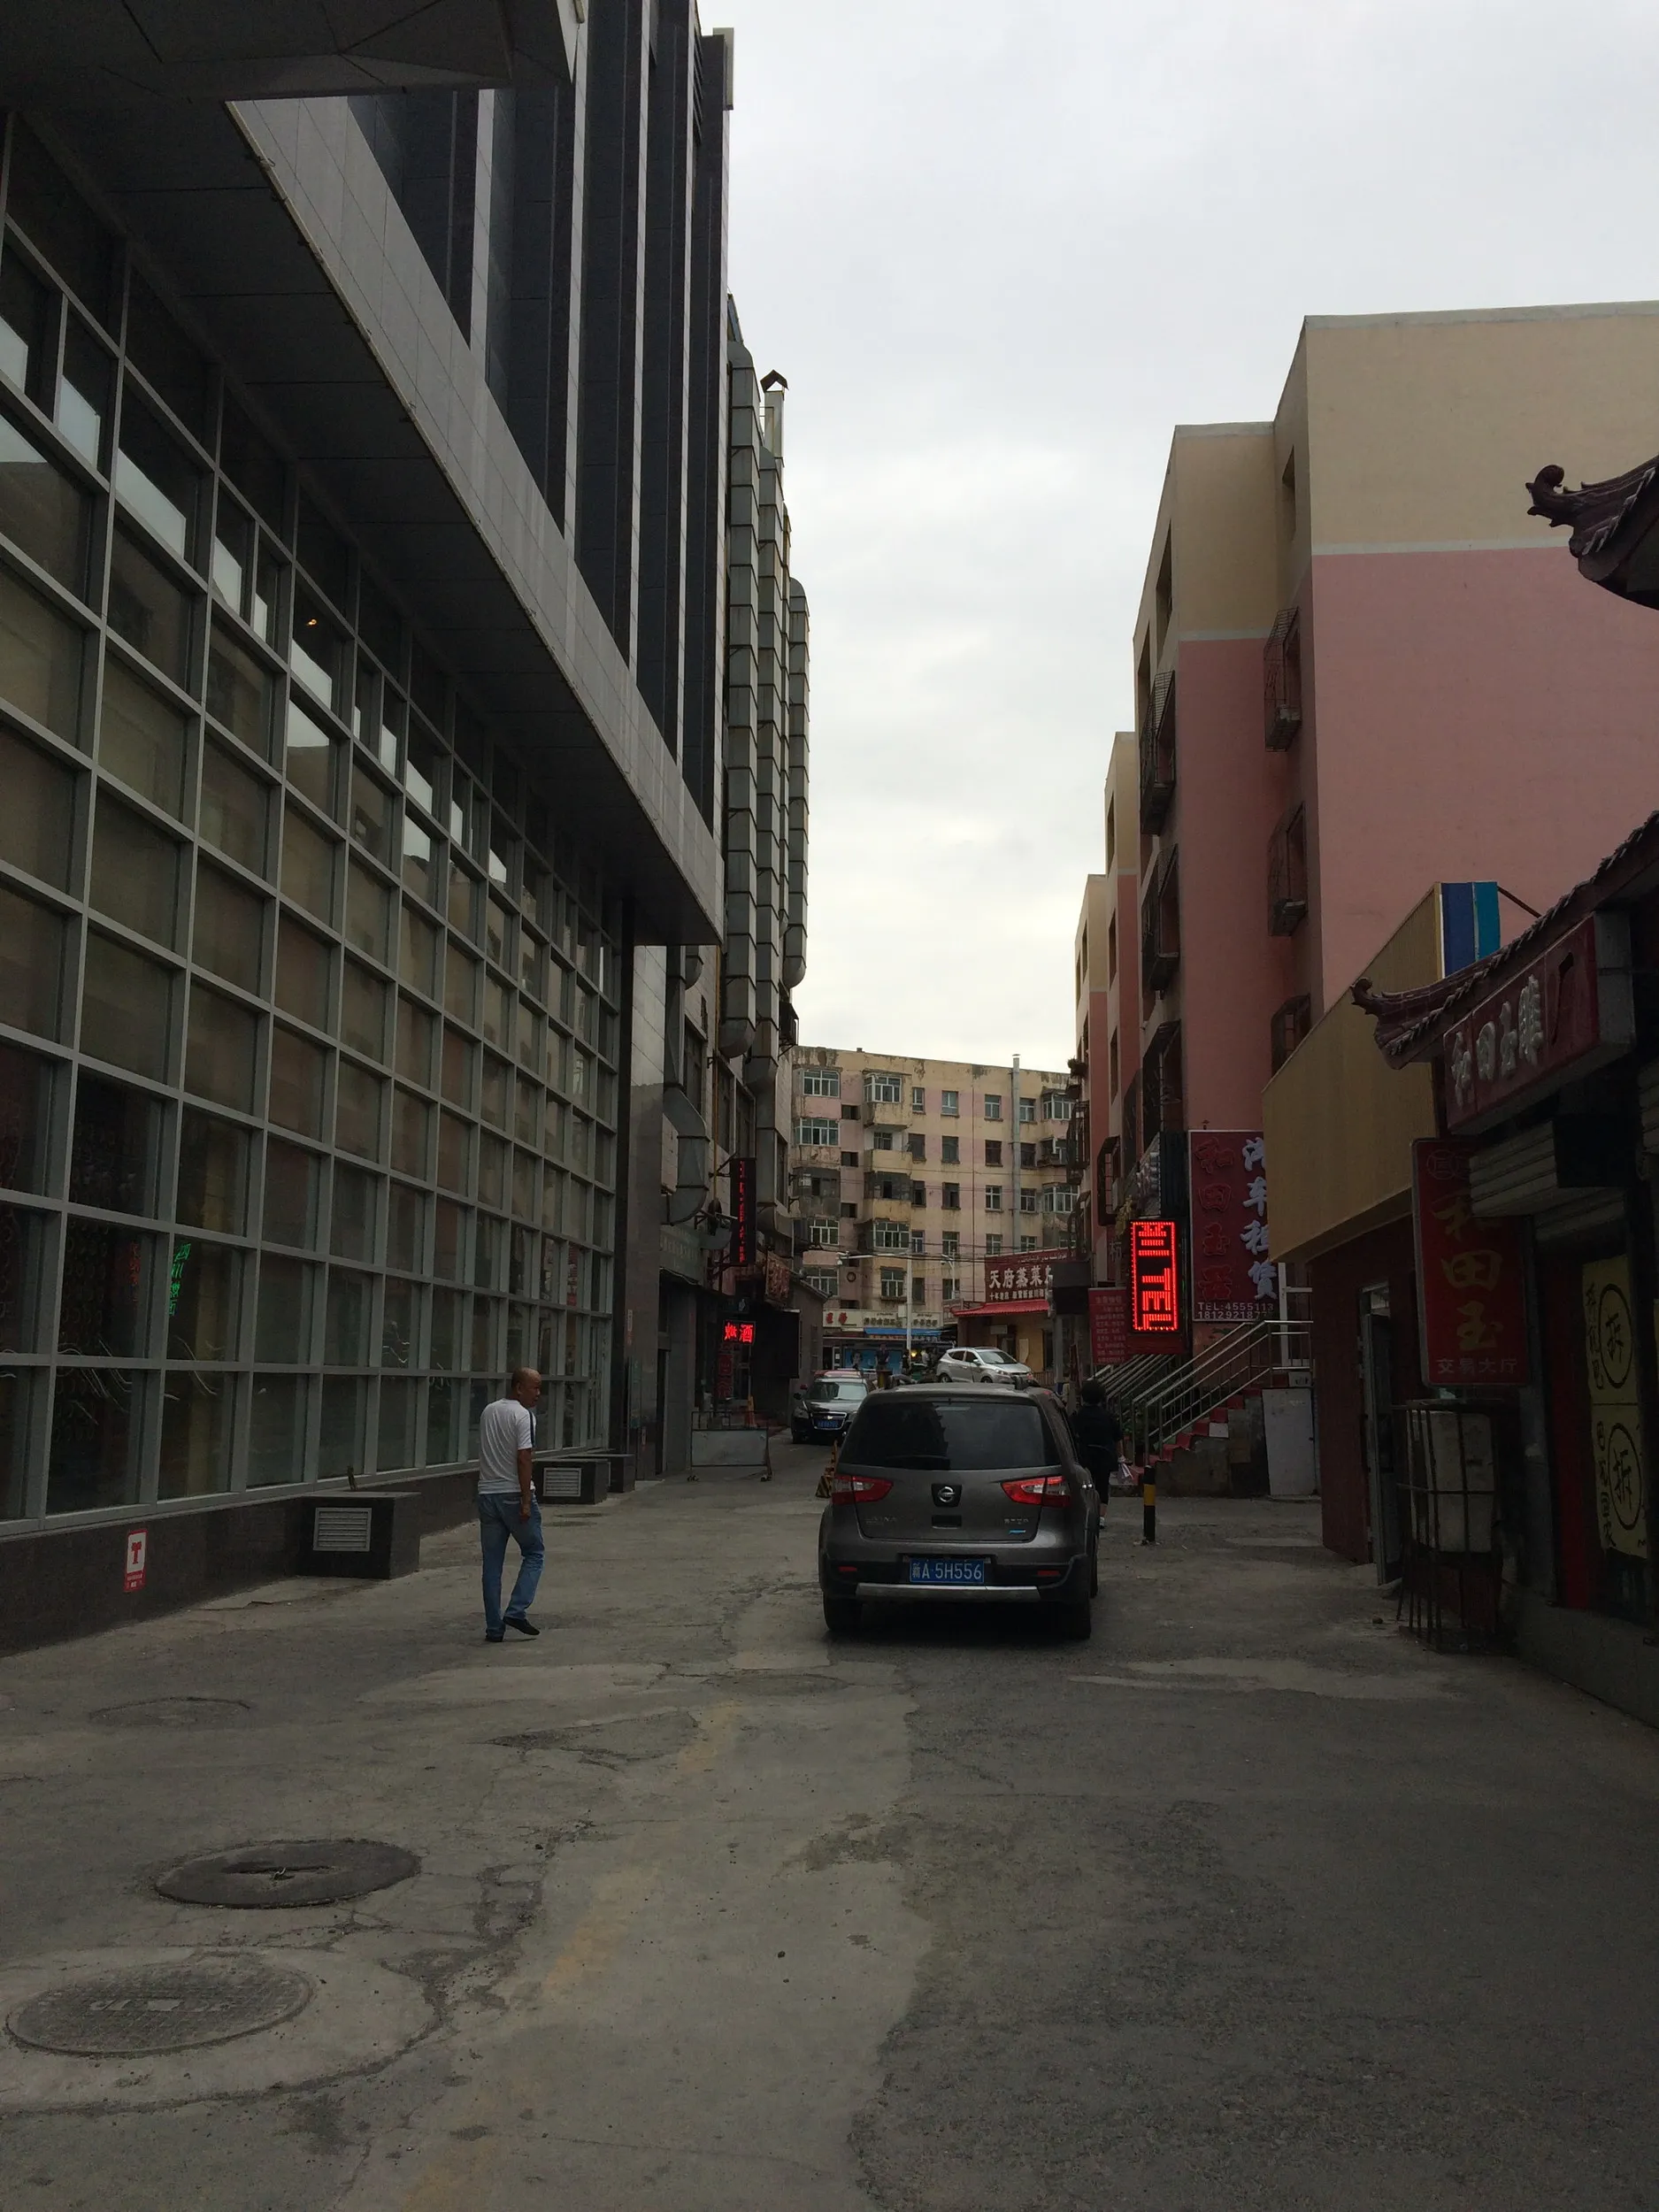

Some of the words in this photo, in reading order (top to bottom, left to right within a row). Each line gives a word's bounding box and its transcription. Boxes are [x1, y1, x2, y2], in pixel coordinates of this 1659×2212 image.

[724, 1322, 754, 1343] 烟酒
[1437, 1358, 1517, 1375] 交易大厅
